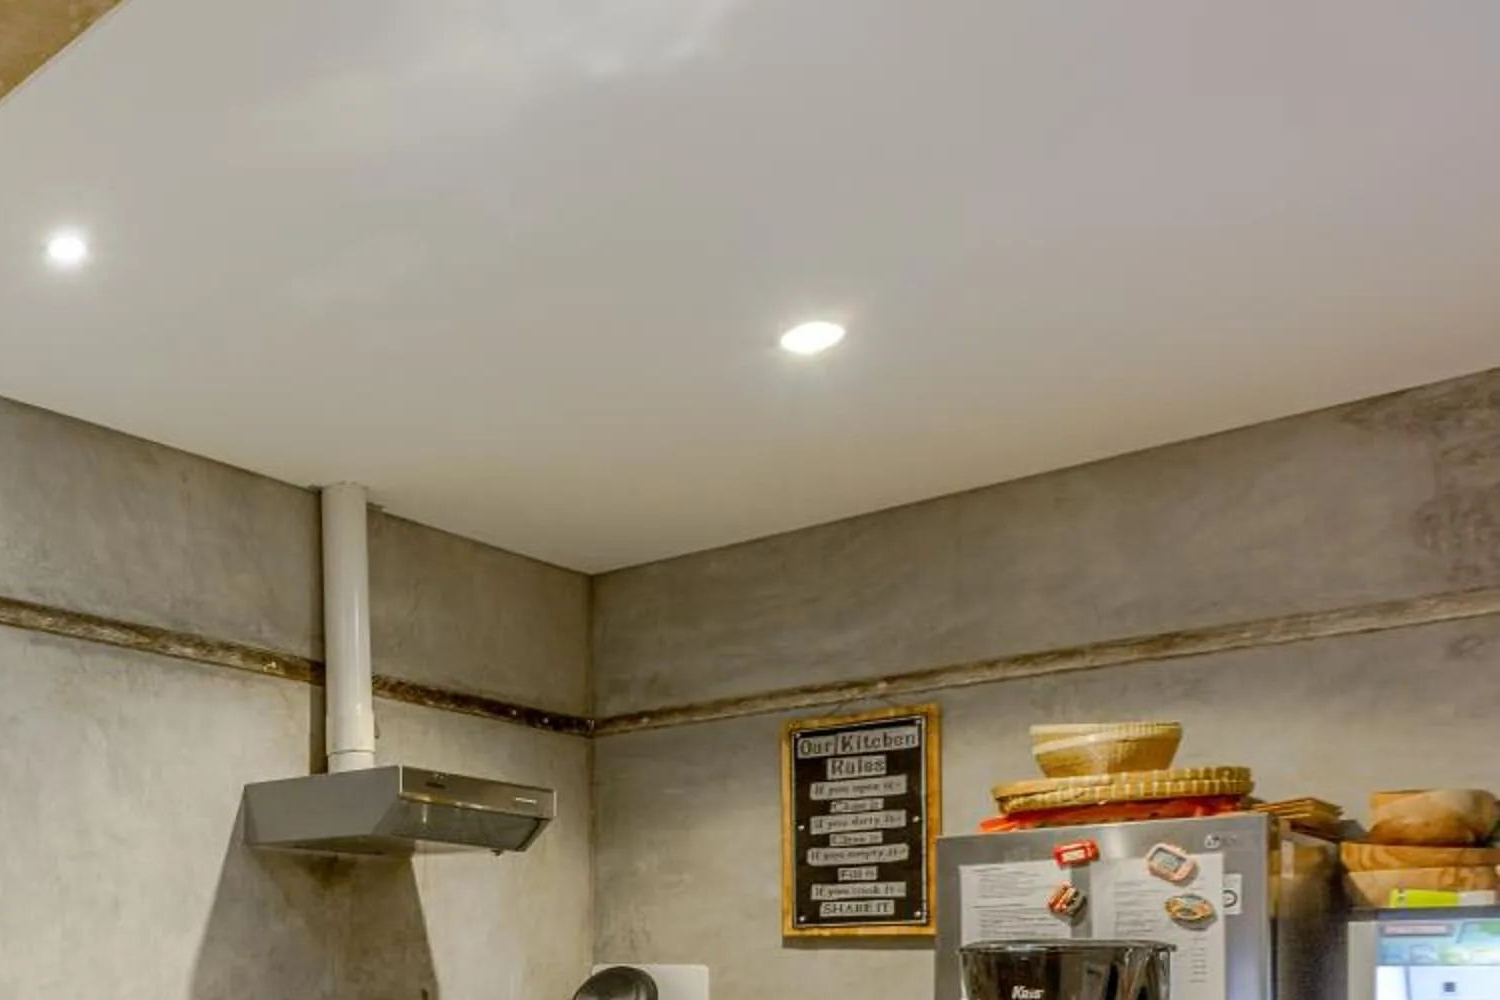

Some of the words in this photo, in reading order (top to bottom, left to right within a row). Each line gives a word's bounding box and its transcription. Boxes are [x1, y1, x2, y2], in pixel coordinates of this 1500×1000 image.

[800, 738, 831, 756] Our
[841, 731, 917, 754] Kitchen
[831, 757, 886, 777] Rules
